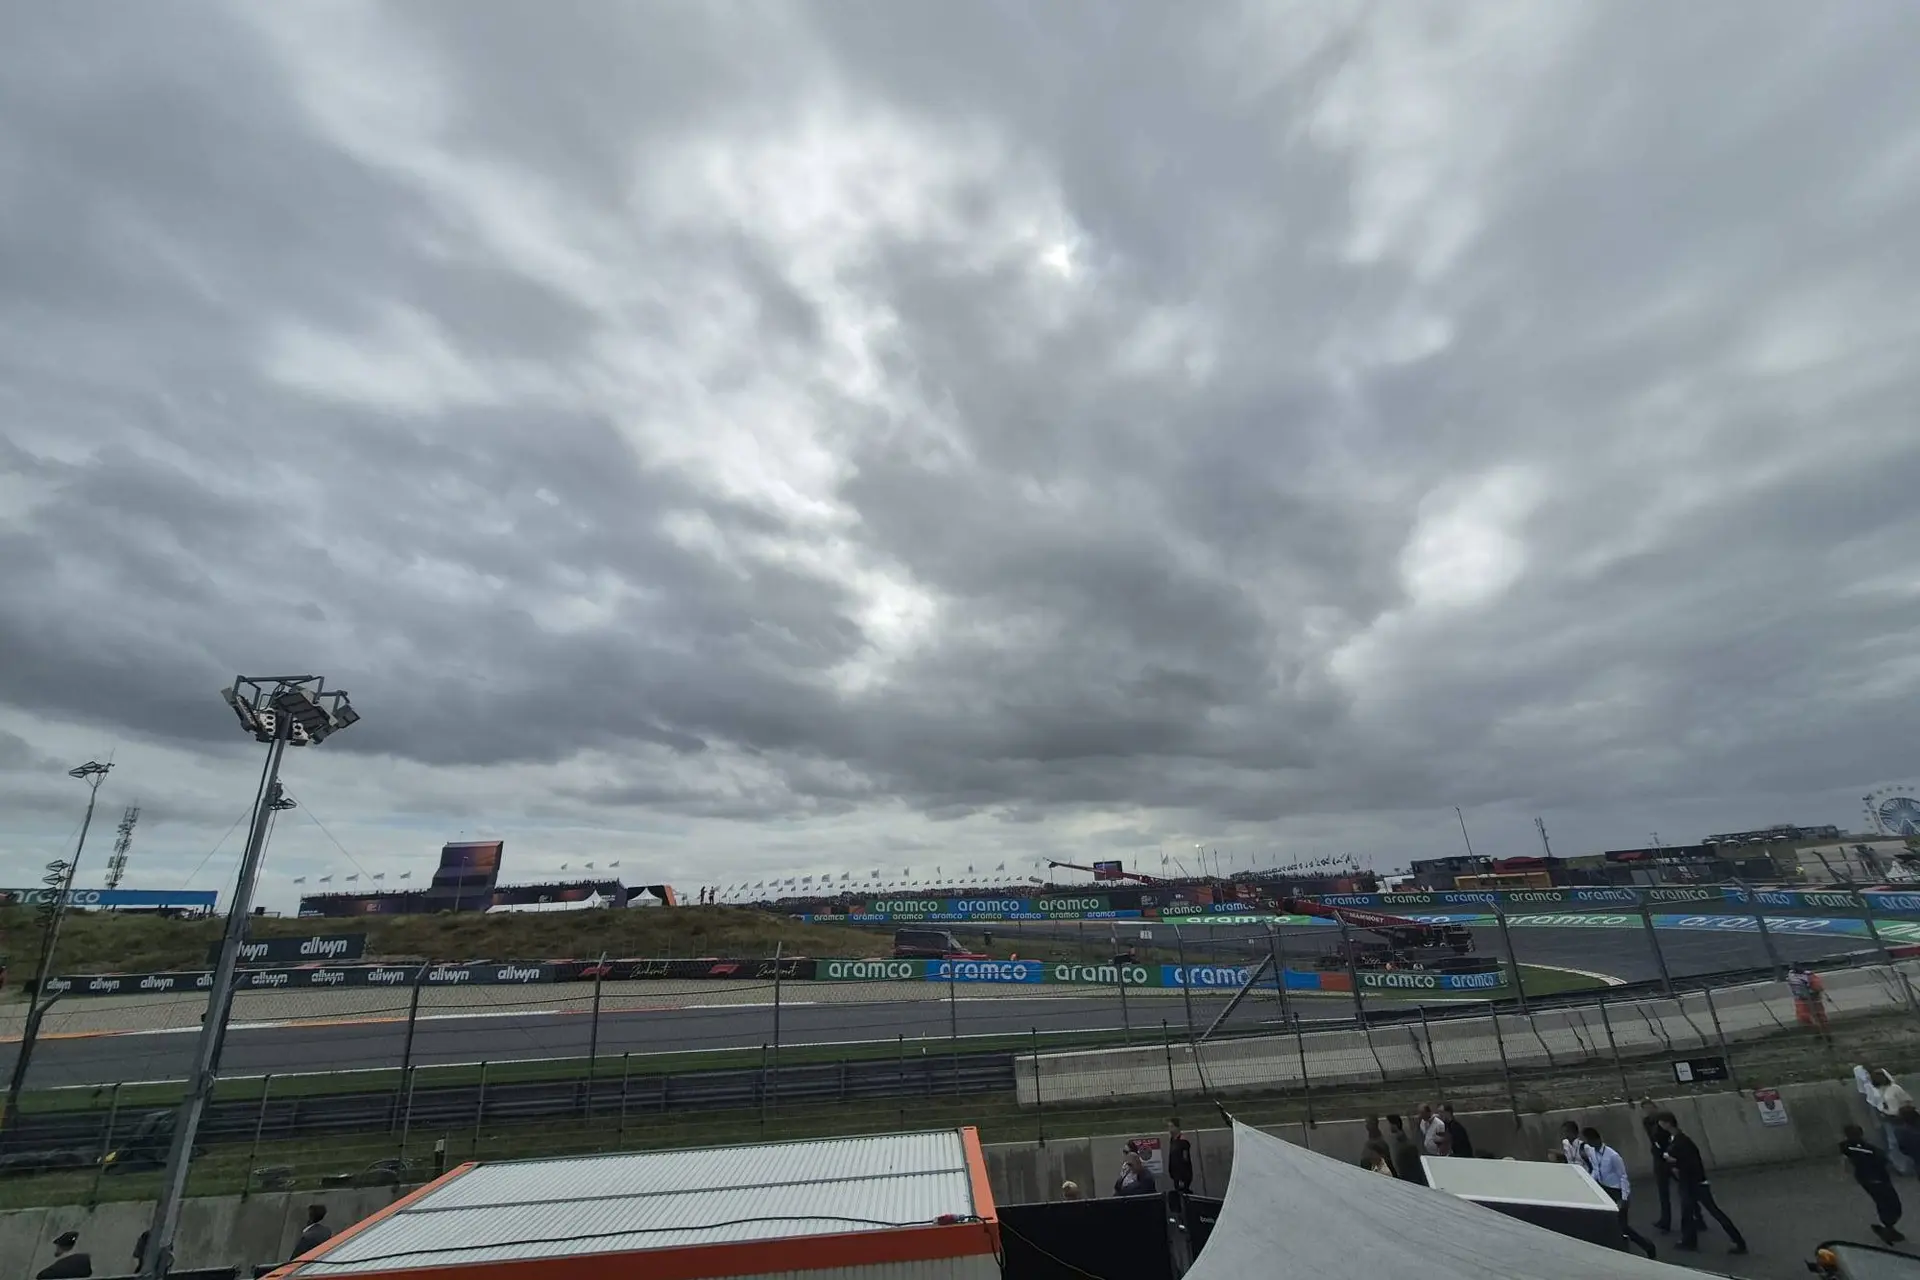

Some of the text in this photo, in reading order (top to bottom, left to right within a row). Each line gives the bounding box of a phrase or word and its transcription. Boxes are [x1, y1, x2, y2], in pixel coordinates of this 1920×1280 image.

[1324, 896, 1369, 905] aramco
[1384, 894, 1431, 904] aramco
[1445, 892, 1495, 903] aramco
[1510, 891, 1562, 902] aramco
[1649, 888, 1709, 900] aramco
[875, 900, 938, 912] aramco
[957, 900, 1019, 911] aramco
[1039, 898, 1099, 911] aramco
[1163, 905, 1203, 915] aramco
[813, 913, 845, 921] aramco
[853, 913, 884, 921] aramco
[1087, 910, 1116, 918] aramco
[236, 940, 269, 961] lwyn
[300, 936, 348, 958] allwyn
[311, 970, 344, 985] allwyn
[367, 969, 404, 984] allwyn
[429, 966, 470, 984] allwyn
[497, 965, 540, 983] allwyn
[829, 962, 913, 978] aramco
[940, 963, 1027, 980] aramco
[1055, 964, 1148, 983] aramco
[89, 976, 119, 992] allwyn
[140, 975, 173, 991] allwyn
[252, 971, 288, 987] allwyn
[1364, 973, 1435, 988] aramco
[1451, 973, 1494, 988] aramco
